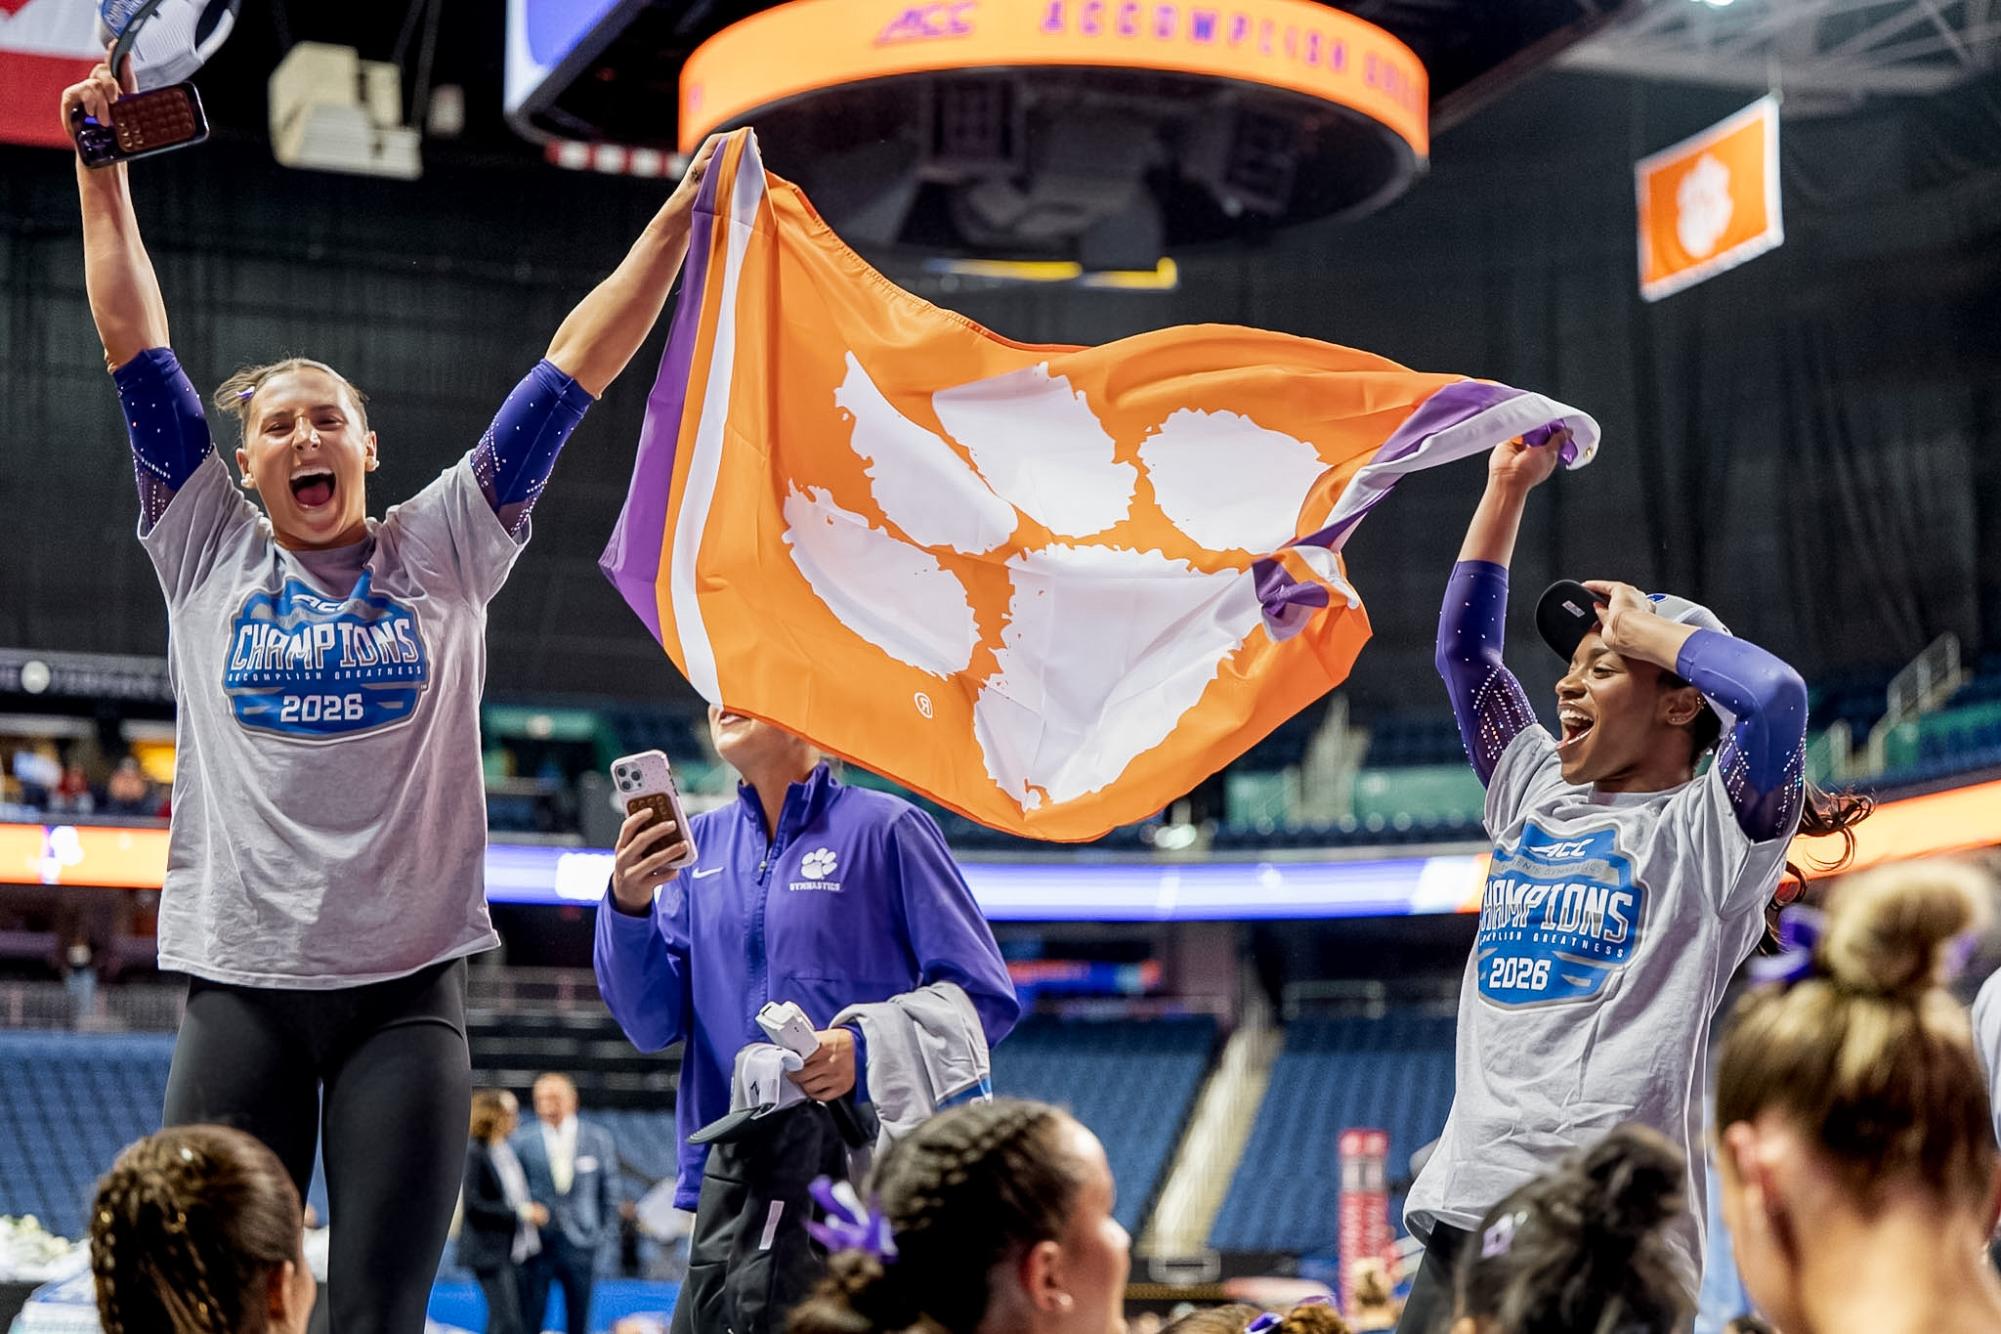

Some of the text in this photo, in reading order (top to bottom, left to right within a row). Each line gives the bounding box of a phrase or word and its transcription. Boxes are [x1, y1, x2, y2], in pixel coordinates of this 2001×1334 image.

[231, 619, 419, 670] CHAMPIONS
[280, 693, 364, 722] 2026
[1530, 838, 1595, 858] ACC
[789, 882, 840, 891] GYMNASTICS
[1533, 932, 1624, 958] GREATNESS
[1489, 957, 1551, 990] 2026
